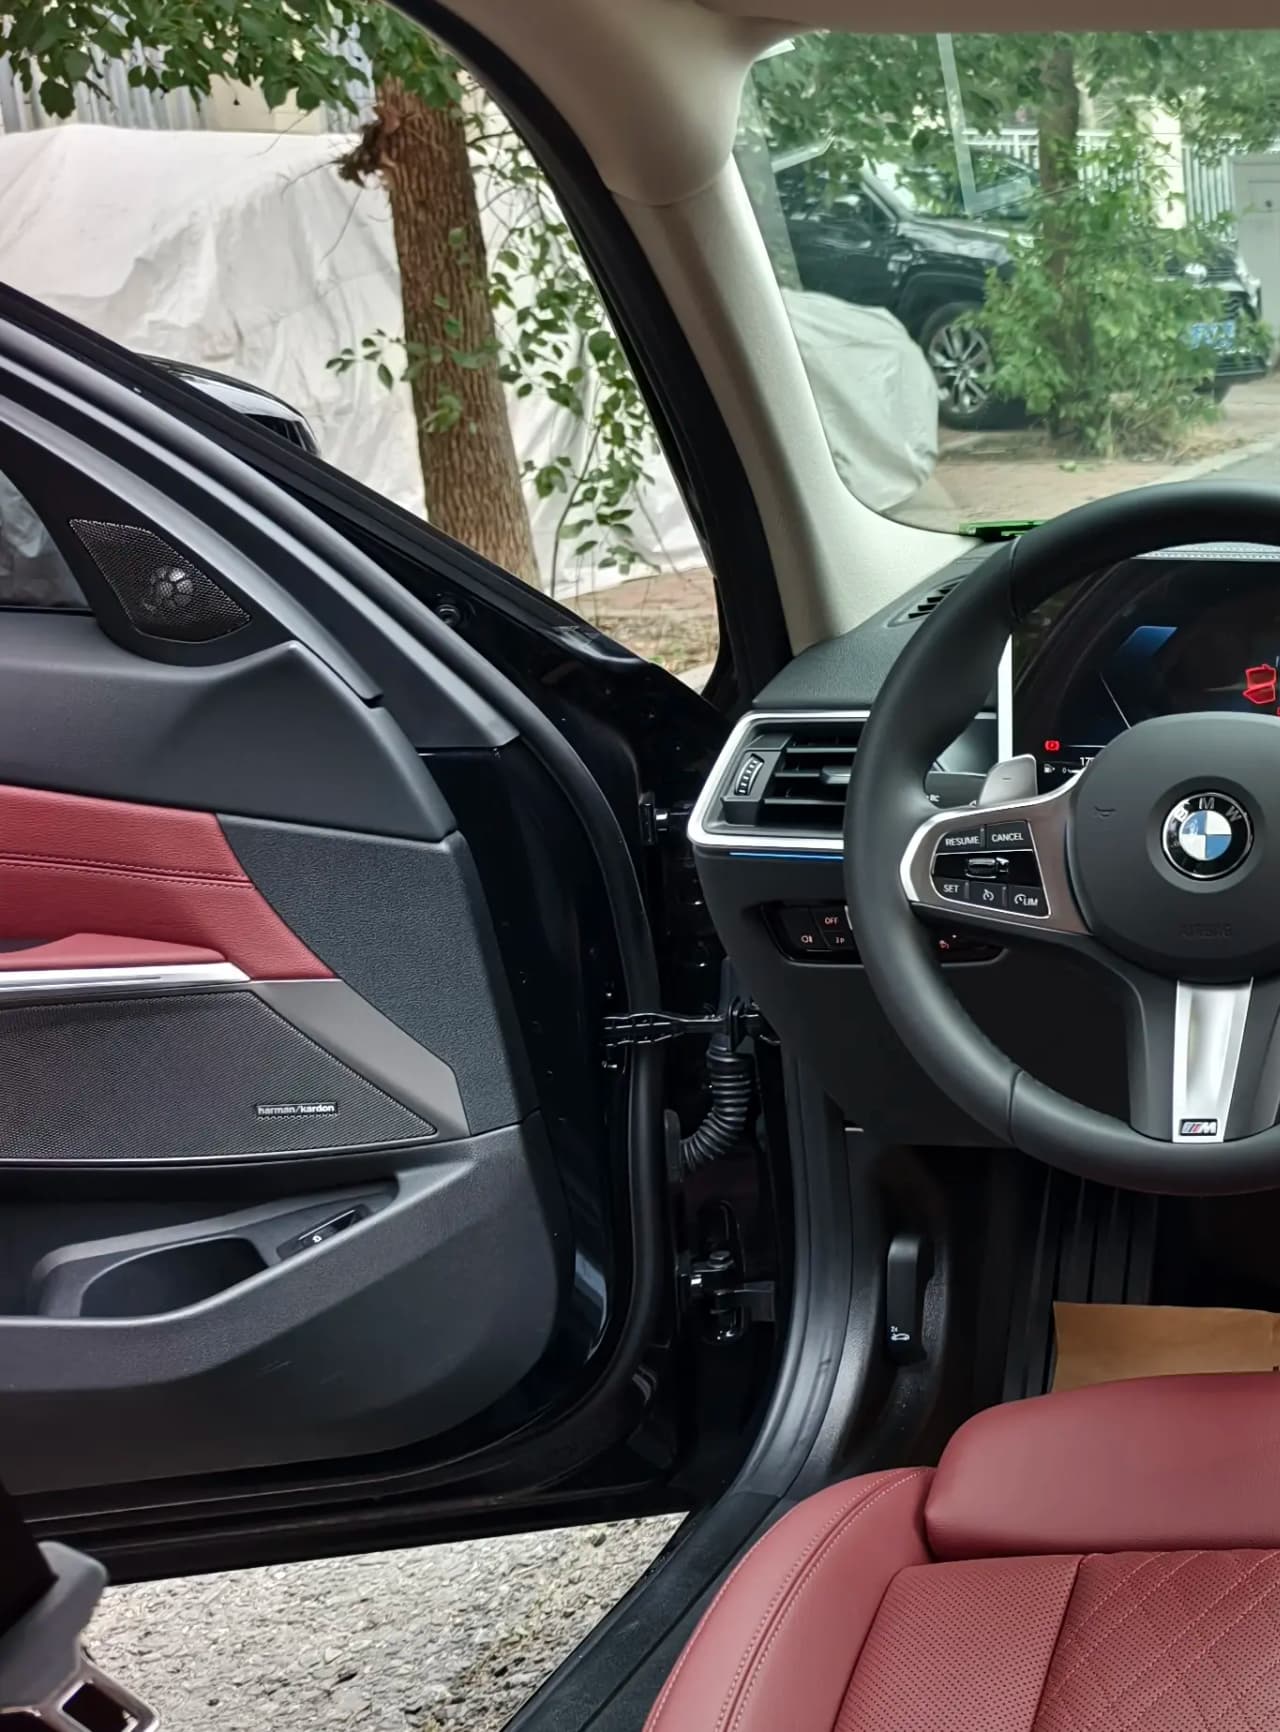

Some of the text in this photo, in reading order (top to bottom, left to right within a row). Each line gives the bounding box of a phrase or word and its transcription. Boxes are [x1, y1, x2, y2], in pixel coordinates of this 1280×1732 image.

[1172, 797, 1243, 824] BMW
[945, 835, 981, 847] RESUME
[991, 832, 1024, 843] CANCEL
[943, 884, 960, 893] SET
[257, 1104, 335, 1115] harman/kardon
